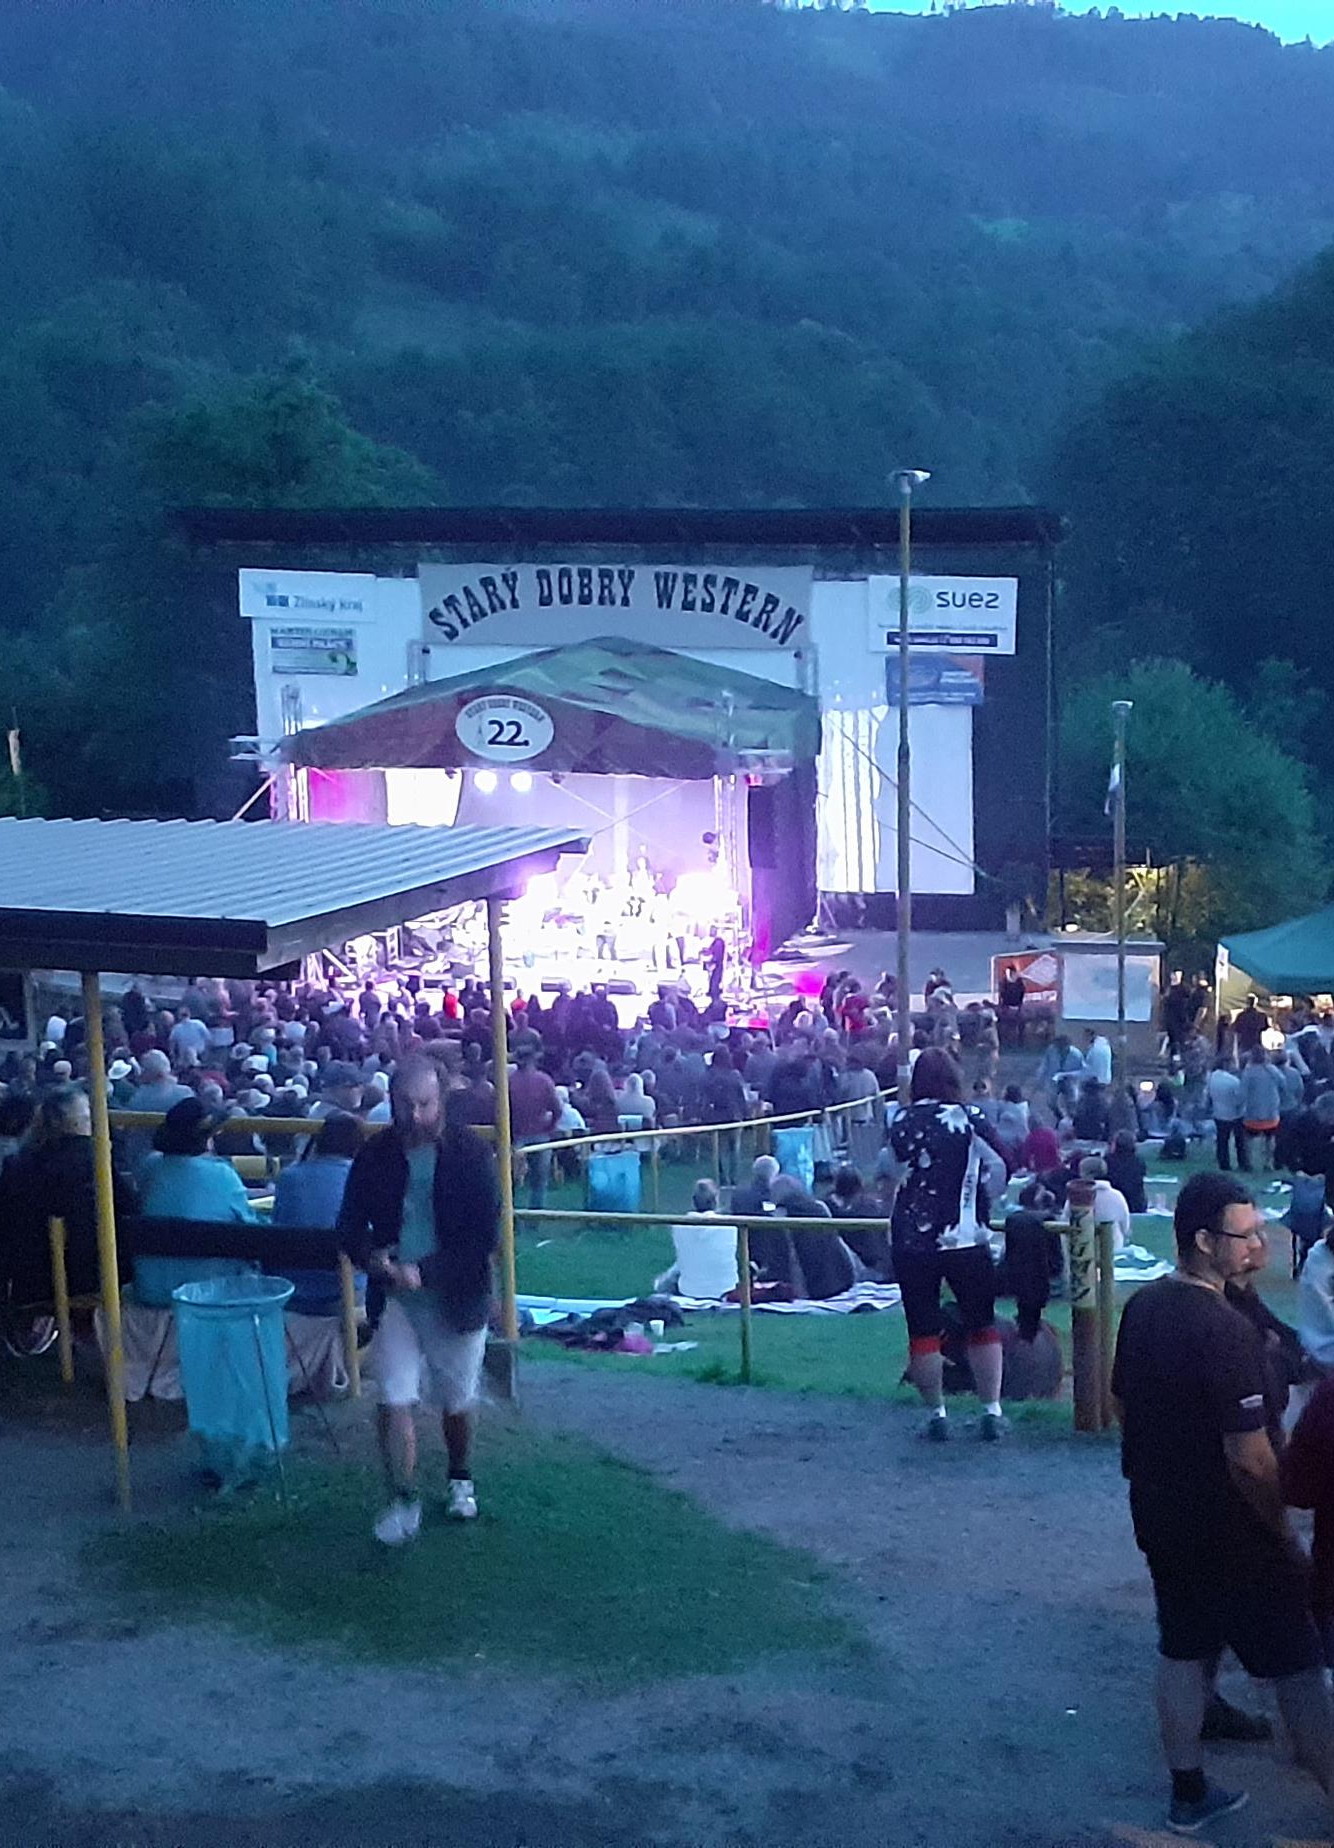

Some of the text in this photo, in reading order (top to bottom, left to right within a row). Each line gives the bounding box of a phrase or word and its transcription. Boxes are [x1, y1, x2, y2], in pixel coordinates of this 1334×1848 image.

[654, 571, 804, 645] WESTERN
[936, 591, 1000, 609] suez
[487, 719, 530, 747] 22.
